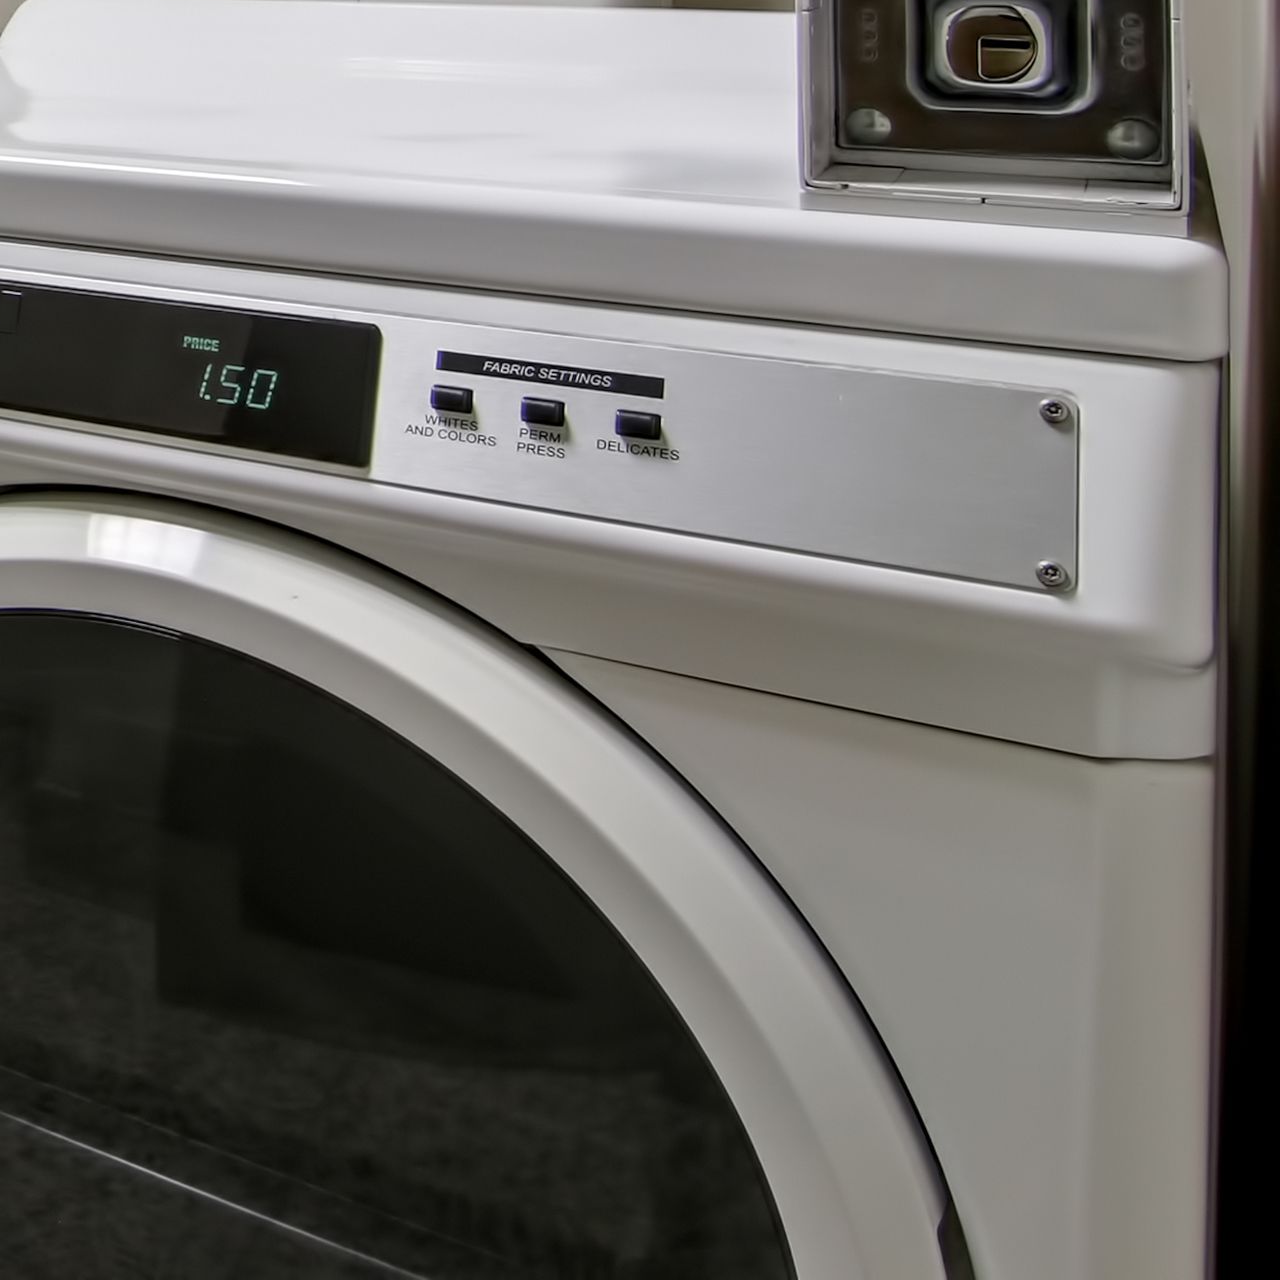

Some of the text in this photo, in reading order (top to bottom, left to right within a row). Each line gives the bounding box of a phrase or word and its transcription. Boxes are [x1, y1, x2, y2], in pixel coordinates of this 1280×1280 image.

[183, 335, 220, 352] PRICE
[482, 361, 613, 388] FABRIC SETTINGS
[199, 363, 278, 410] 1.50
[425, 414, 479, 431] WHITES
[404, 423, 498, 447] AND COLORS
[516, 443, 566, 459] PRESS
[596, 438, 680, 461] DELICATES
